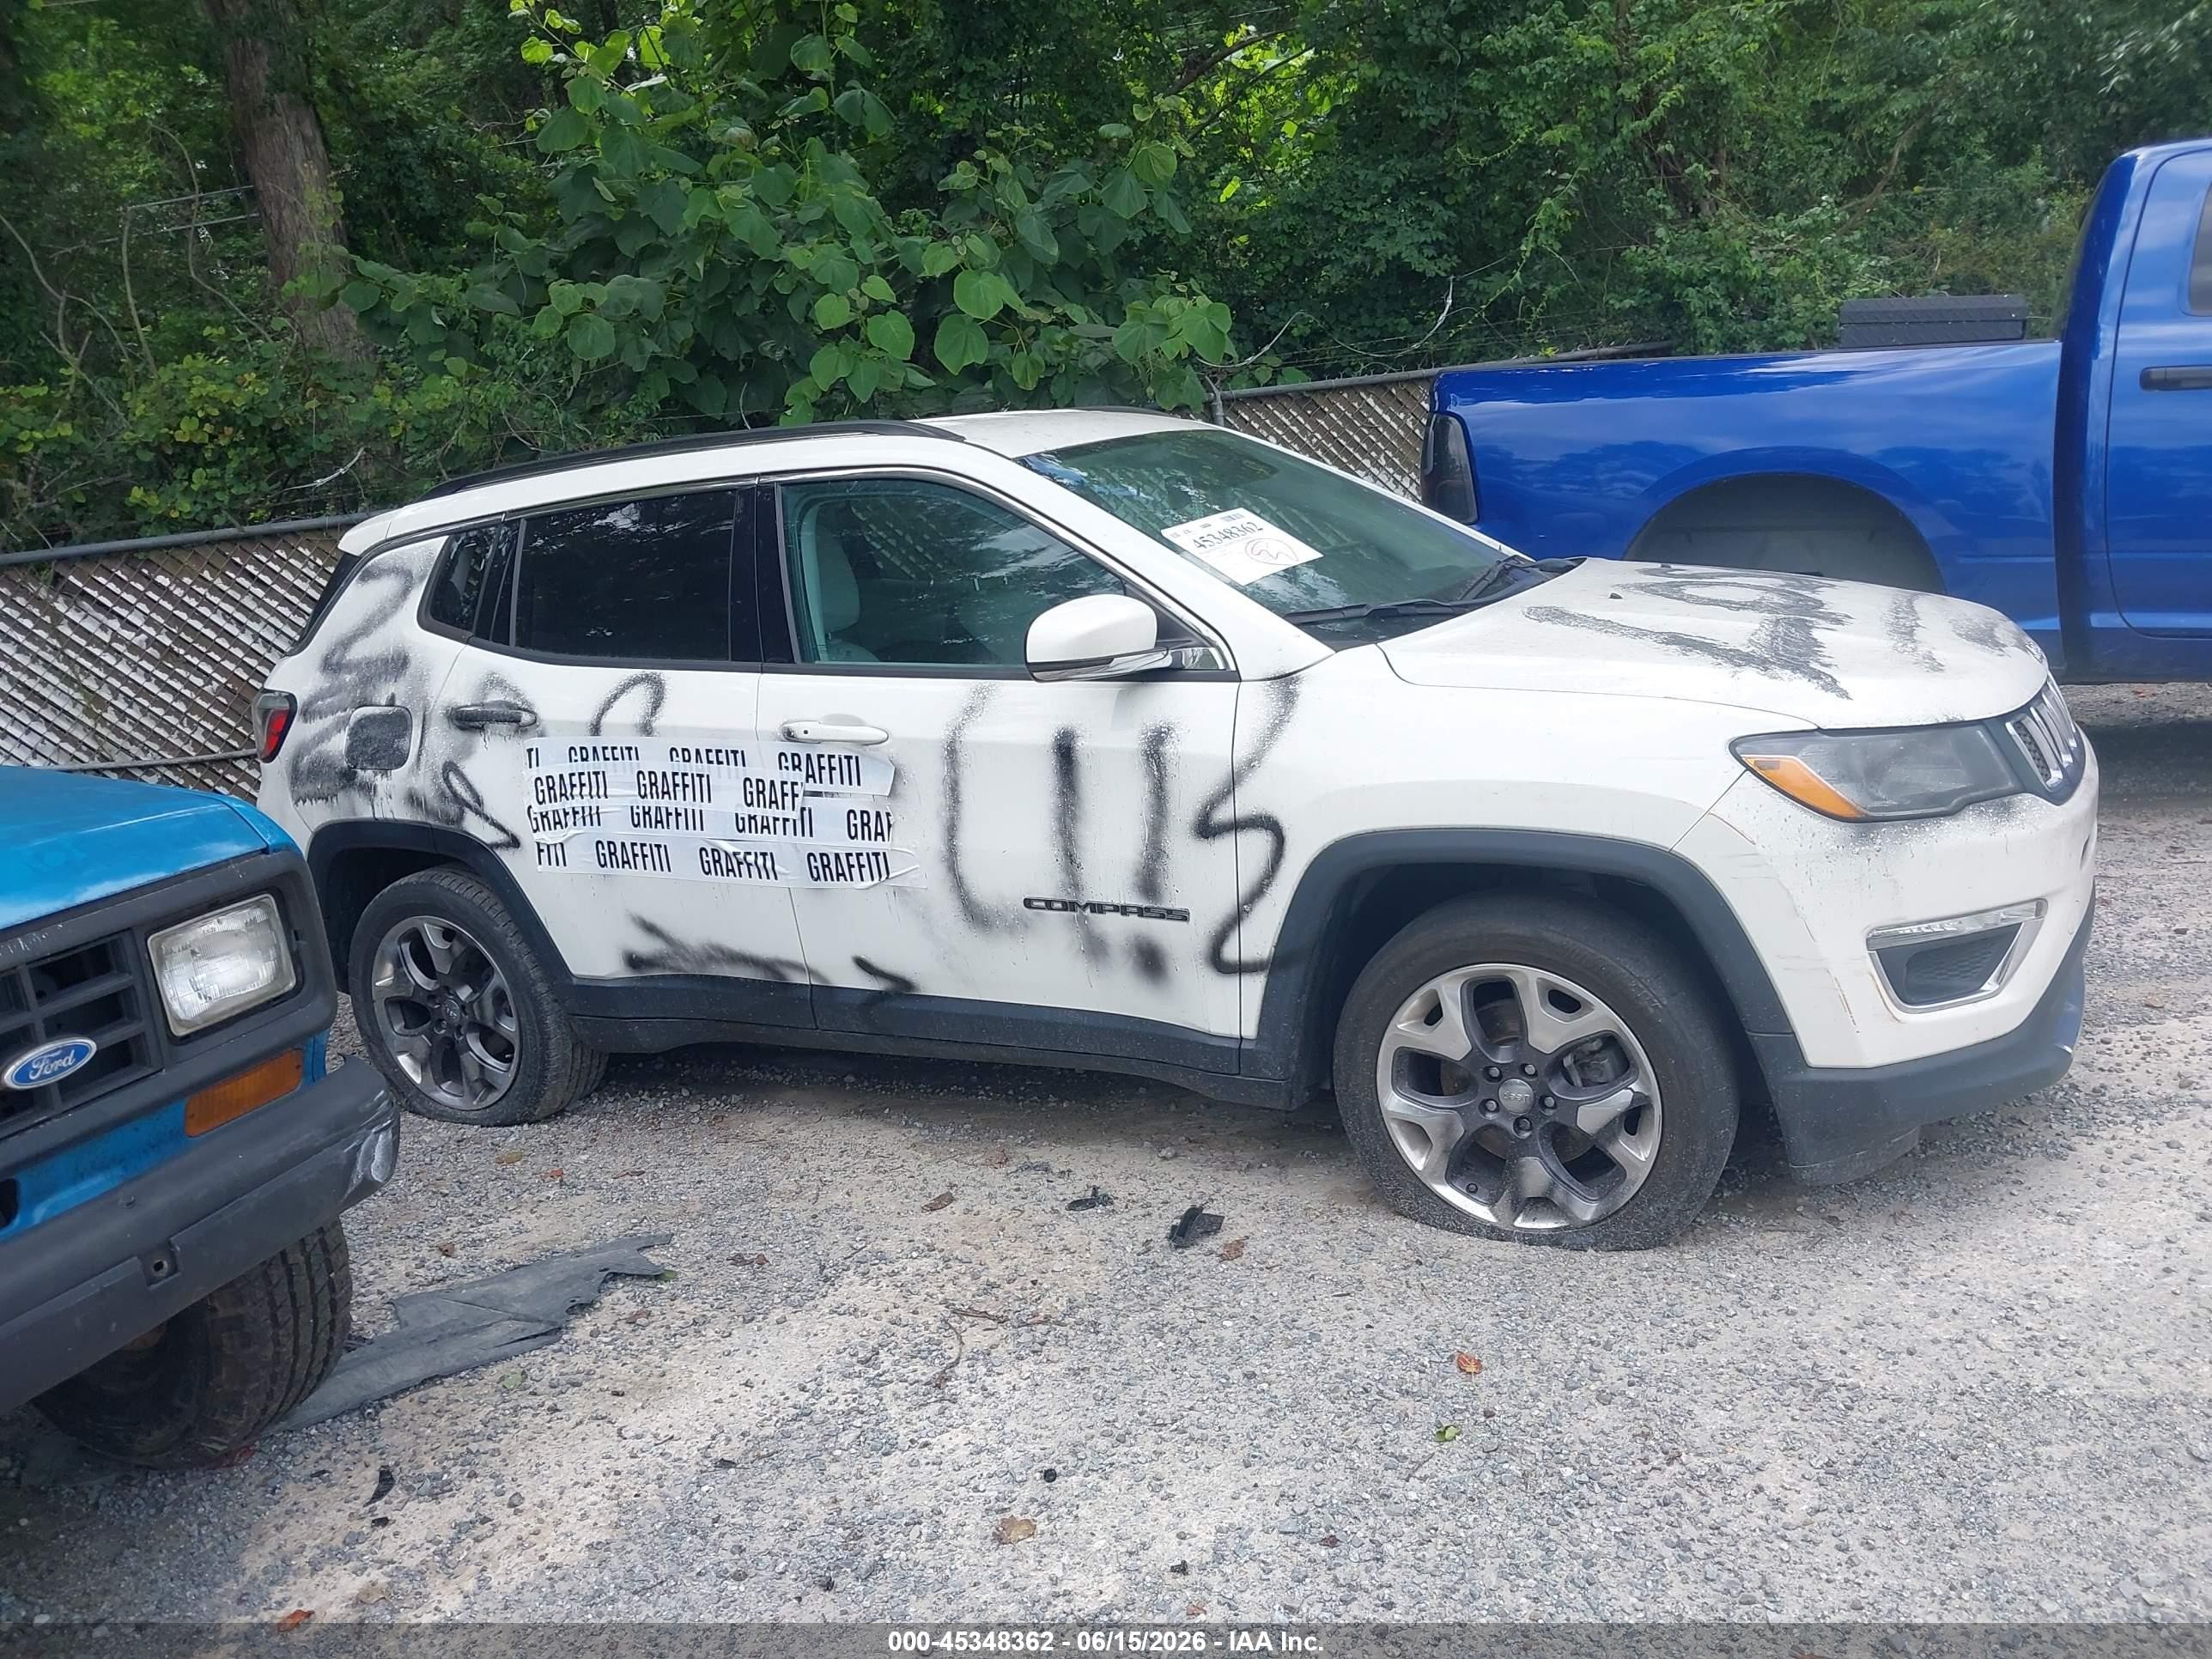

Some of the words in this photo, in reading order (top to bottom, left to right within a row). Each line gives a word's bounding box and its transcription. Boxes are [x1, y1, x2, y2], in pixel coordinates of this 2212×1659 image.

[1193, 521, 1265, 549] 45348362
[778, 751, 861, 787] GRAFFITI
[534, 770, 608, 805] GRAFFITI
[636, 770, 711, 804] GRAFFITI
[743, 777, 804, 811] GRAFF
[595, 840, 672, 873] GRAFFITI
[699, 847, 778, 881] GRAFFITI
[807, 852, 890, 883] GRAFFITI
[1023, 896, 1190, 922] COMPASS
[28, 1049, 76, 1080] Ford
